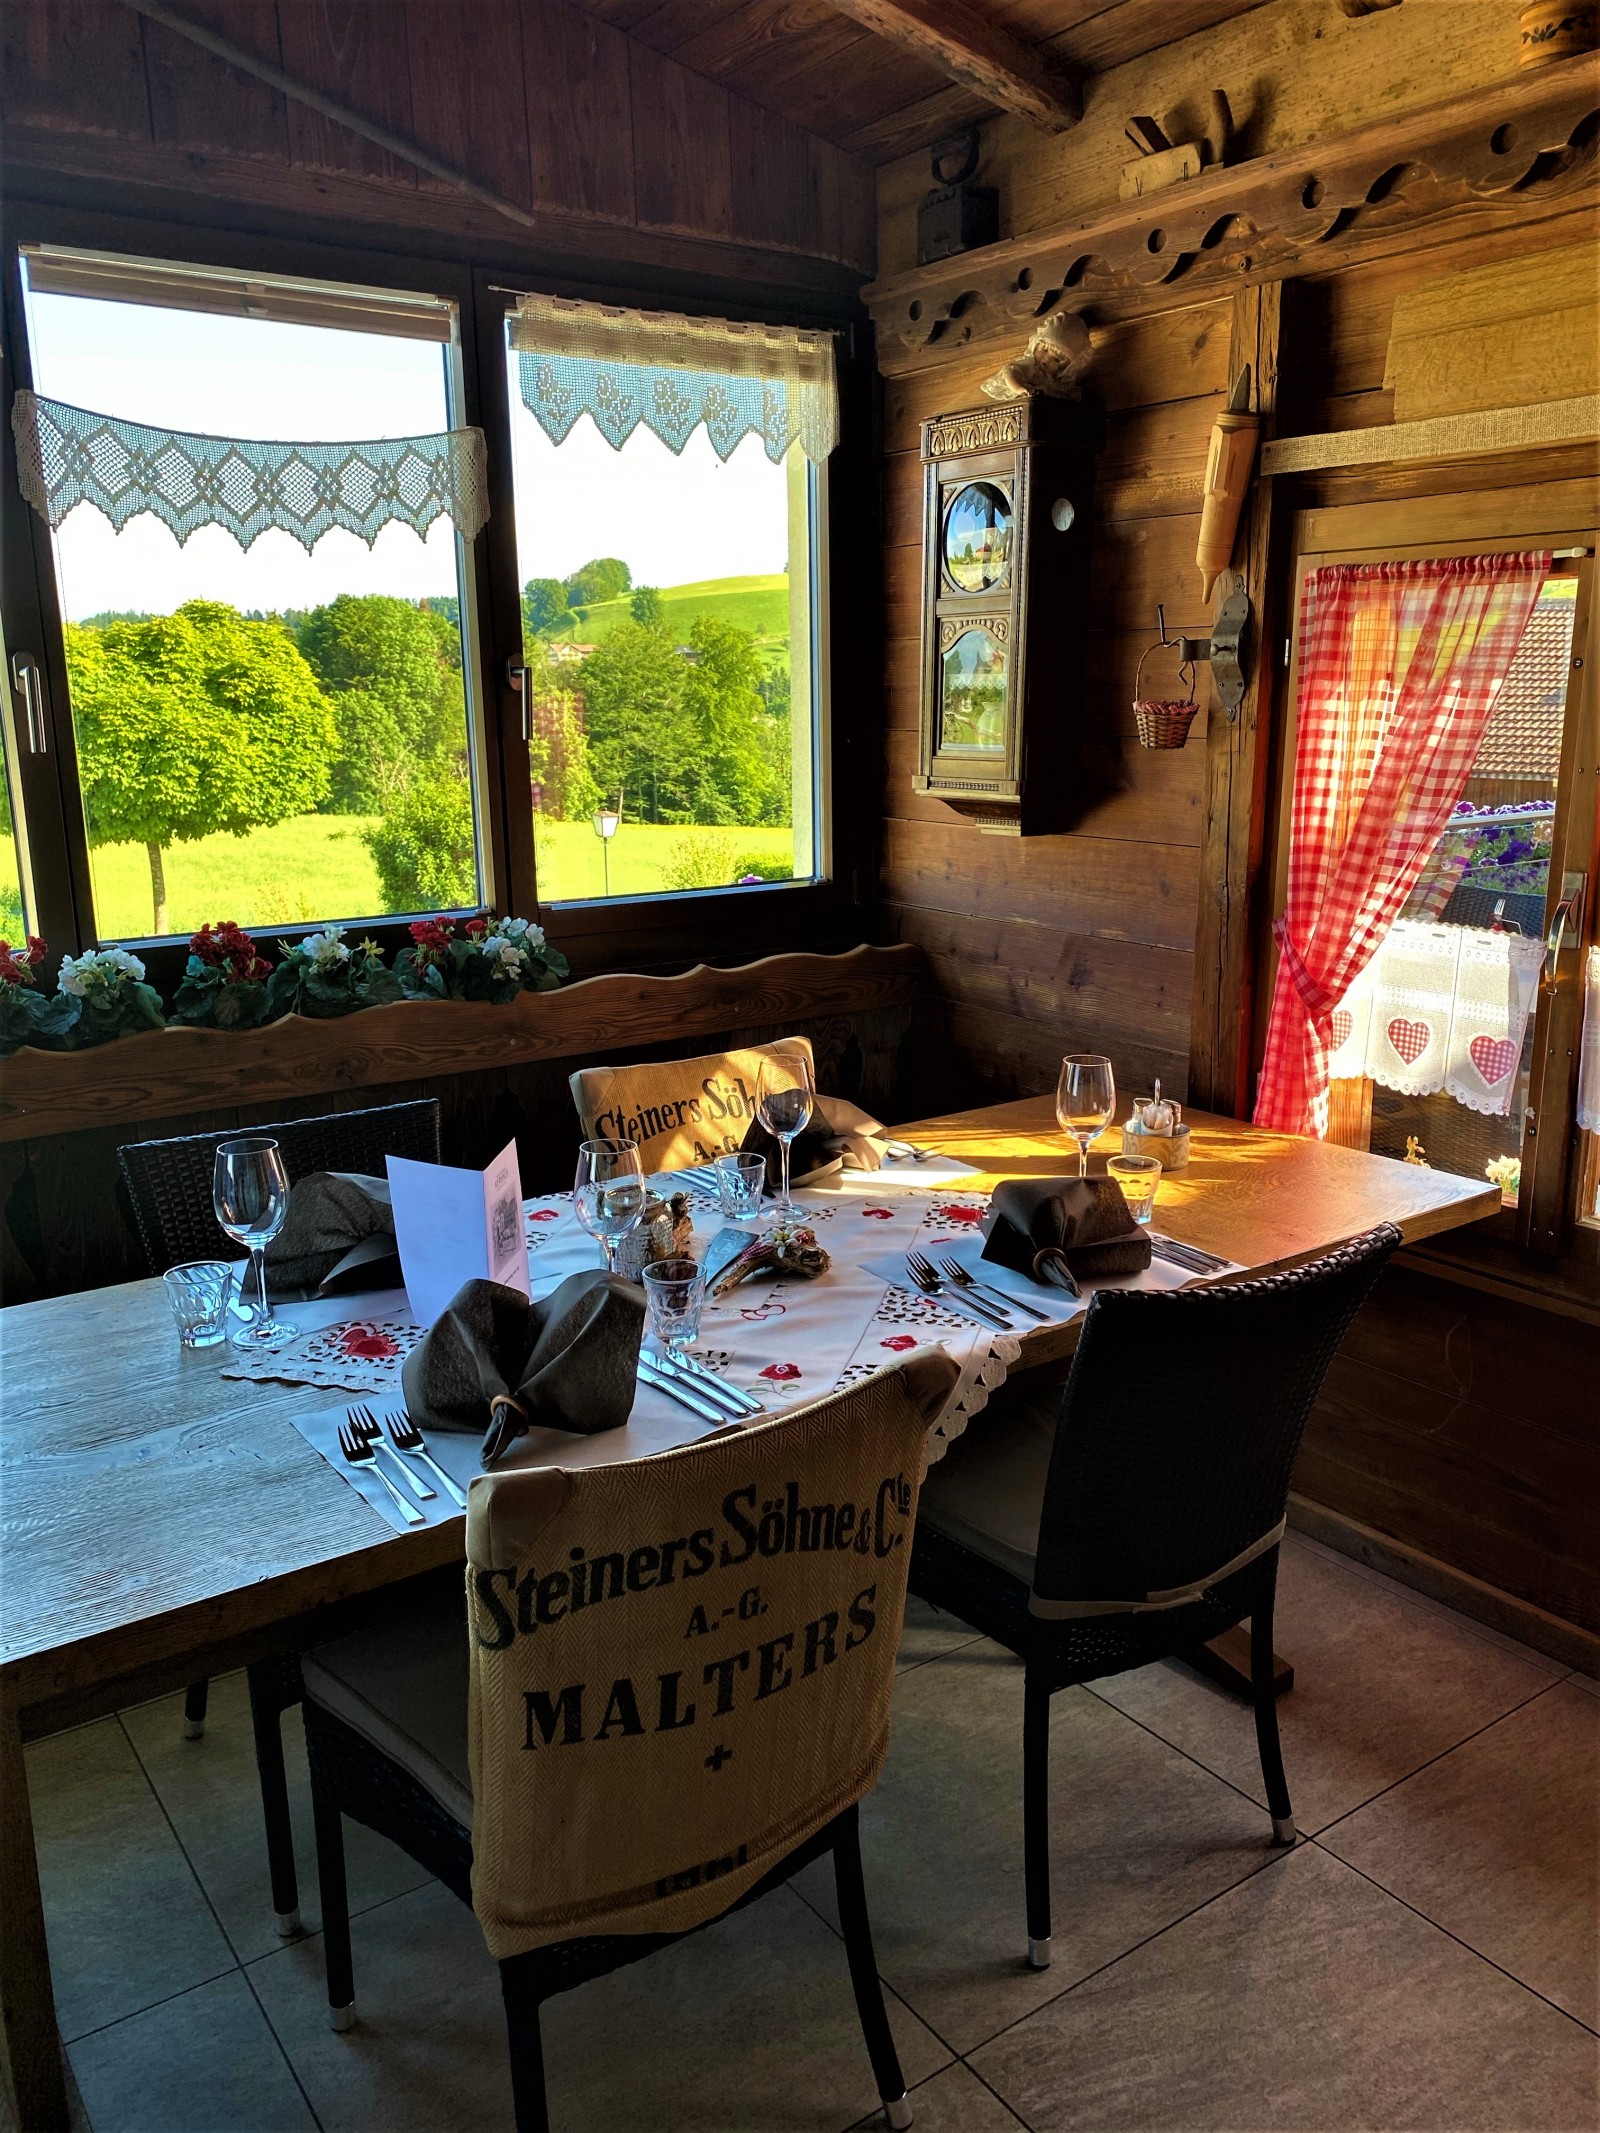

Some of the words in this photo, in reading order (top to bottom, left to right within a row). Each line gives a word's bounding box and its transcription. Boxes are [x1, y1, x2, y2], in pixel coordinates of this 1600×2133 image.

[595, 1098, 702, 1166] Steiners
[702, 1078, 757, 1120] Söh
[476, 1528, 715, 1651] Steiners
[720, 1482, 857, 1566] Söhne
[521, 1582, 877, 1751] MALTERS
